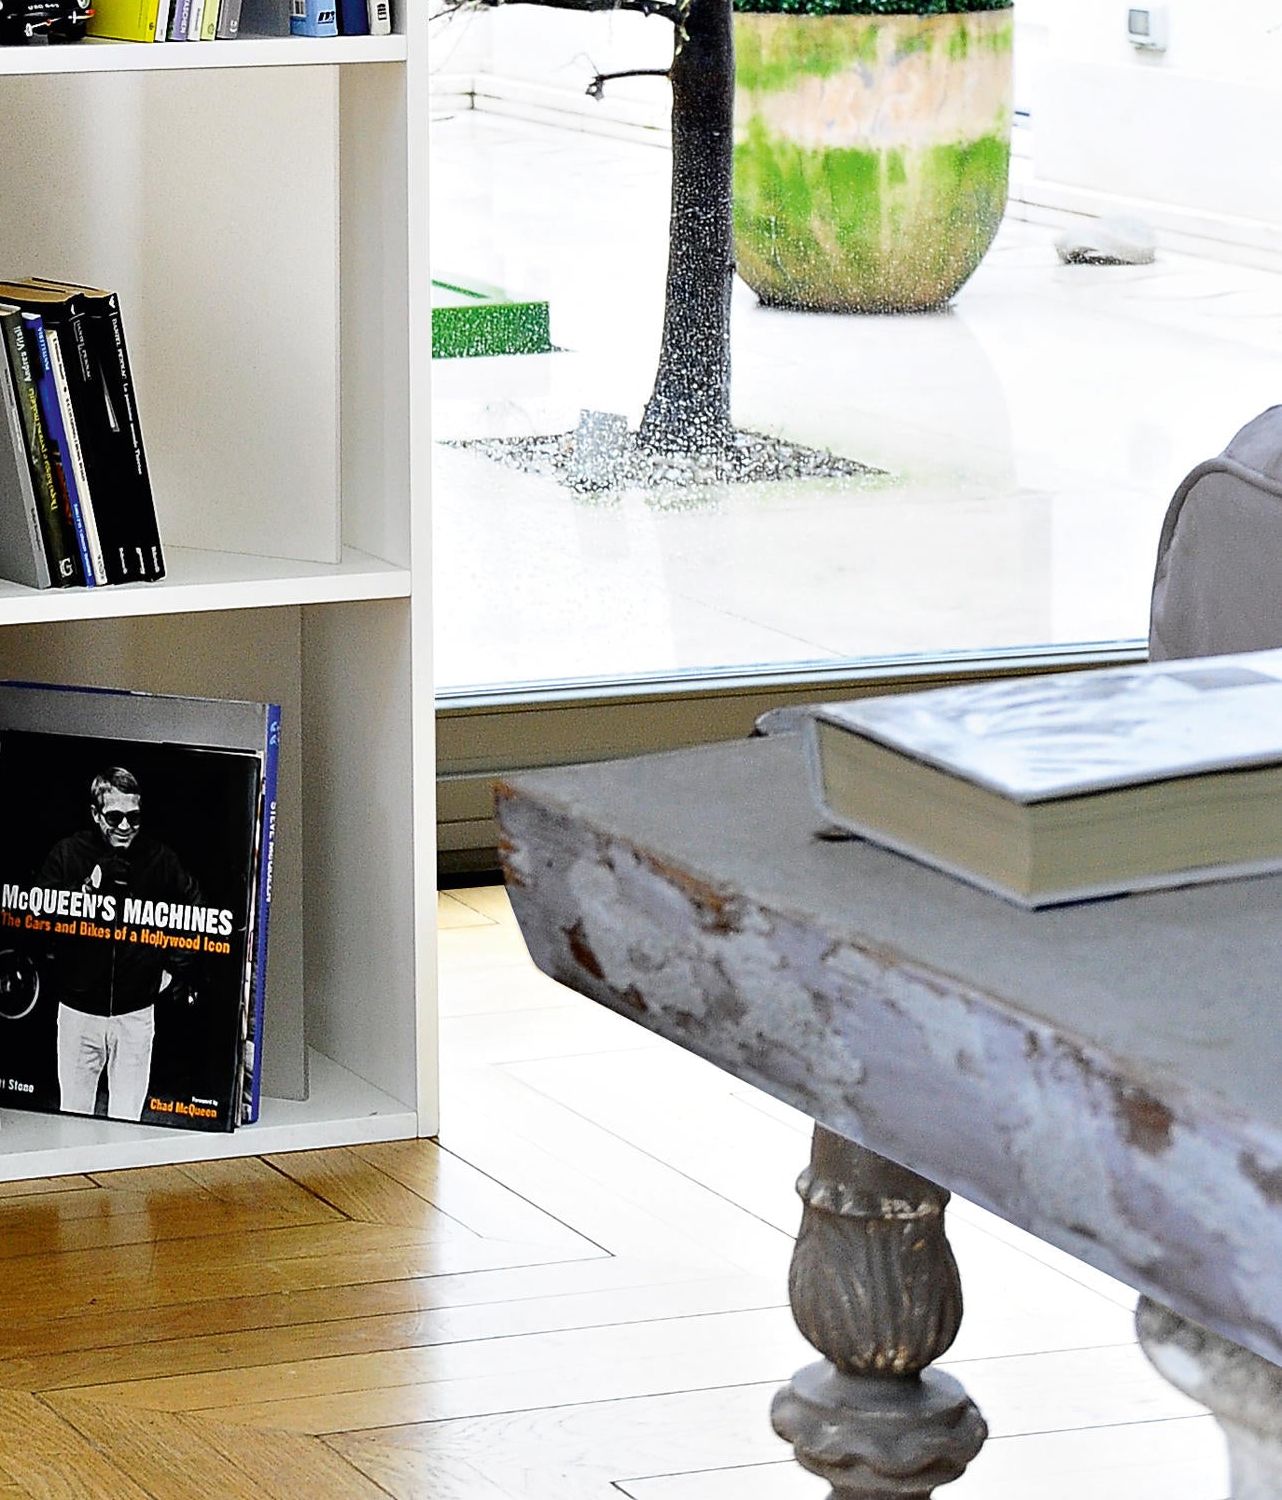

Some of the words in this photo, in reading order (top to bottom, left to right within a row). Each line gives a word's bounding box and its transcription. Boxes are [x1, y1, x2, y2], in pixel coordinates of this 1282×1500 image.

[12, 325, 26, 350] Vitali
[110, 318, 121, 347] DANIEL
[17, 351, 32, 382] Andrea
[115, 348, 127, 379] PENNAC
[2, 884, 117, 921] McQUEEN'S
[123, 898, 234, 936] MACHINES
[1, 911, 22, 927] The
[24, 914, 51, 931] Cars
[54, 920, 76, 934] and
[80, 920, 111, 939] Bikes
[114, 926, 128, 941] of
[129, 930, 137, 943] a
[140, 929, 201, 950] Hollywood
[203, 935, 232, 954] Icon
[8, 1078, 34, 1093] Stone
[150, 1098, 174, 1112] Chad
[175, 1102, 218, 1118] McQueen
